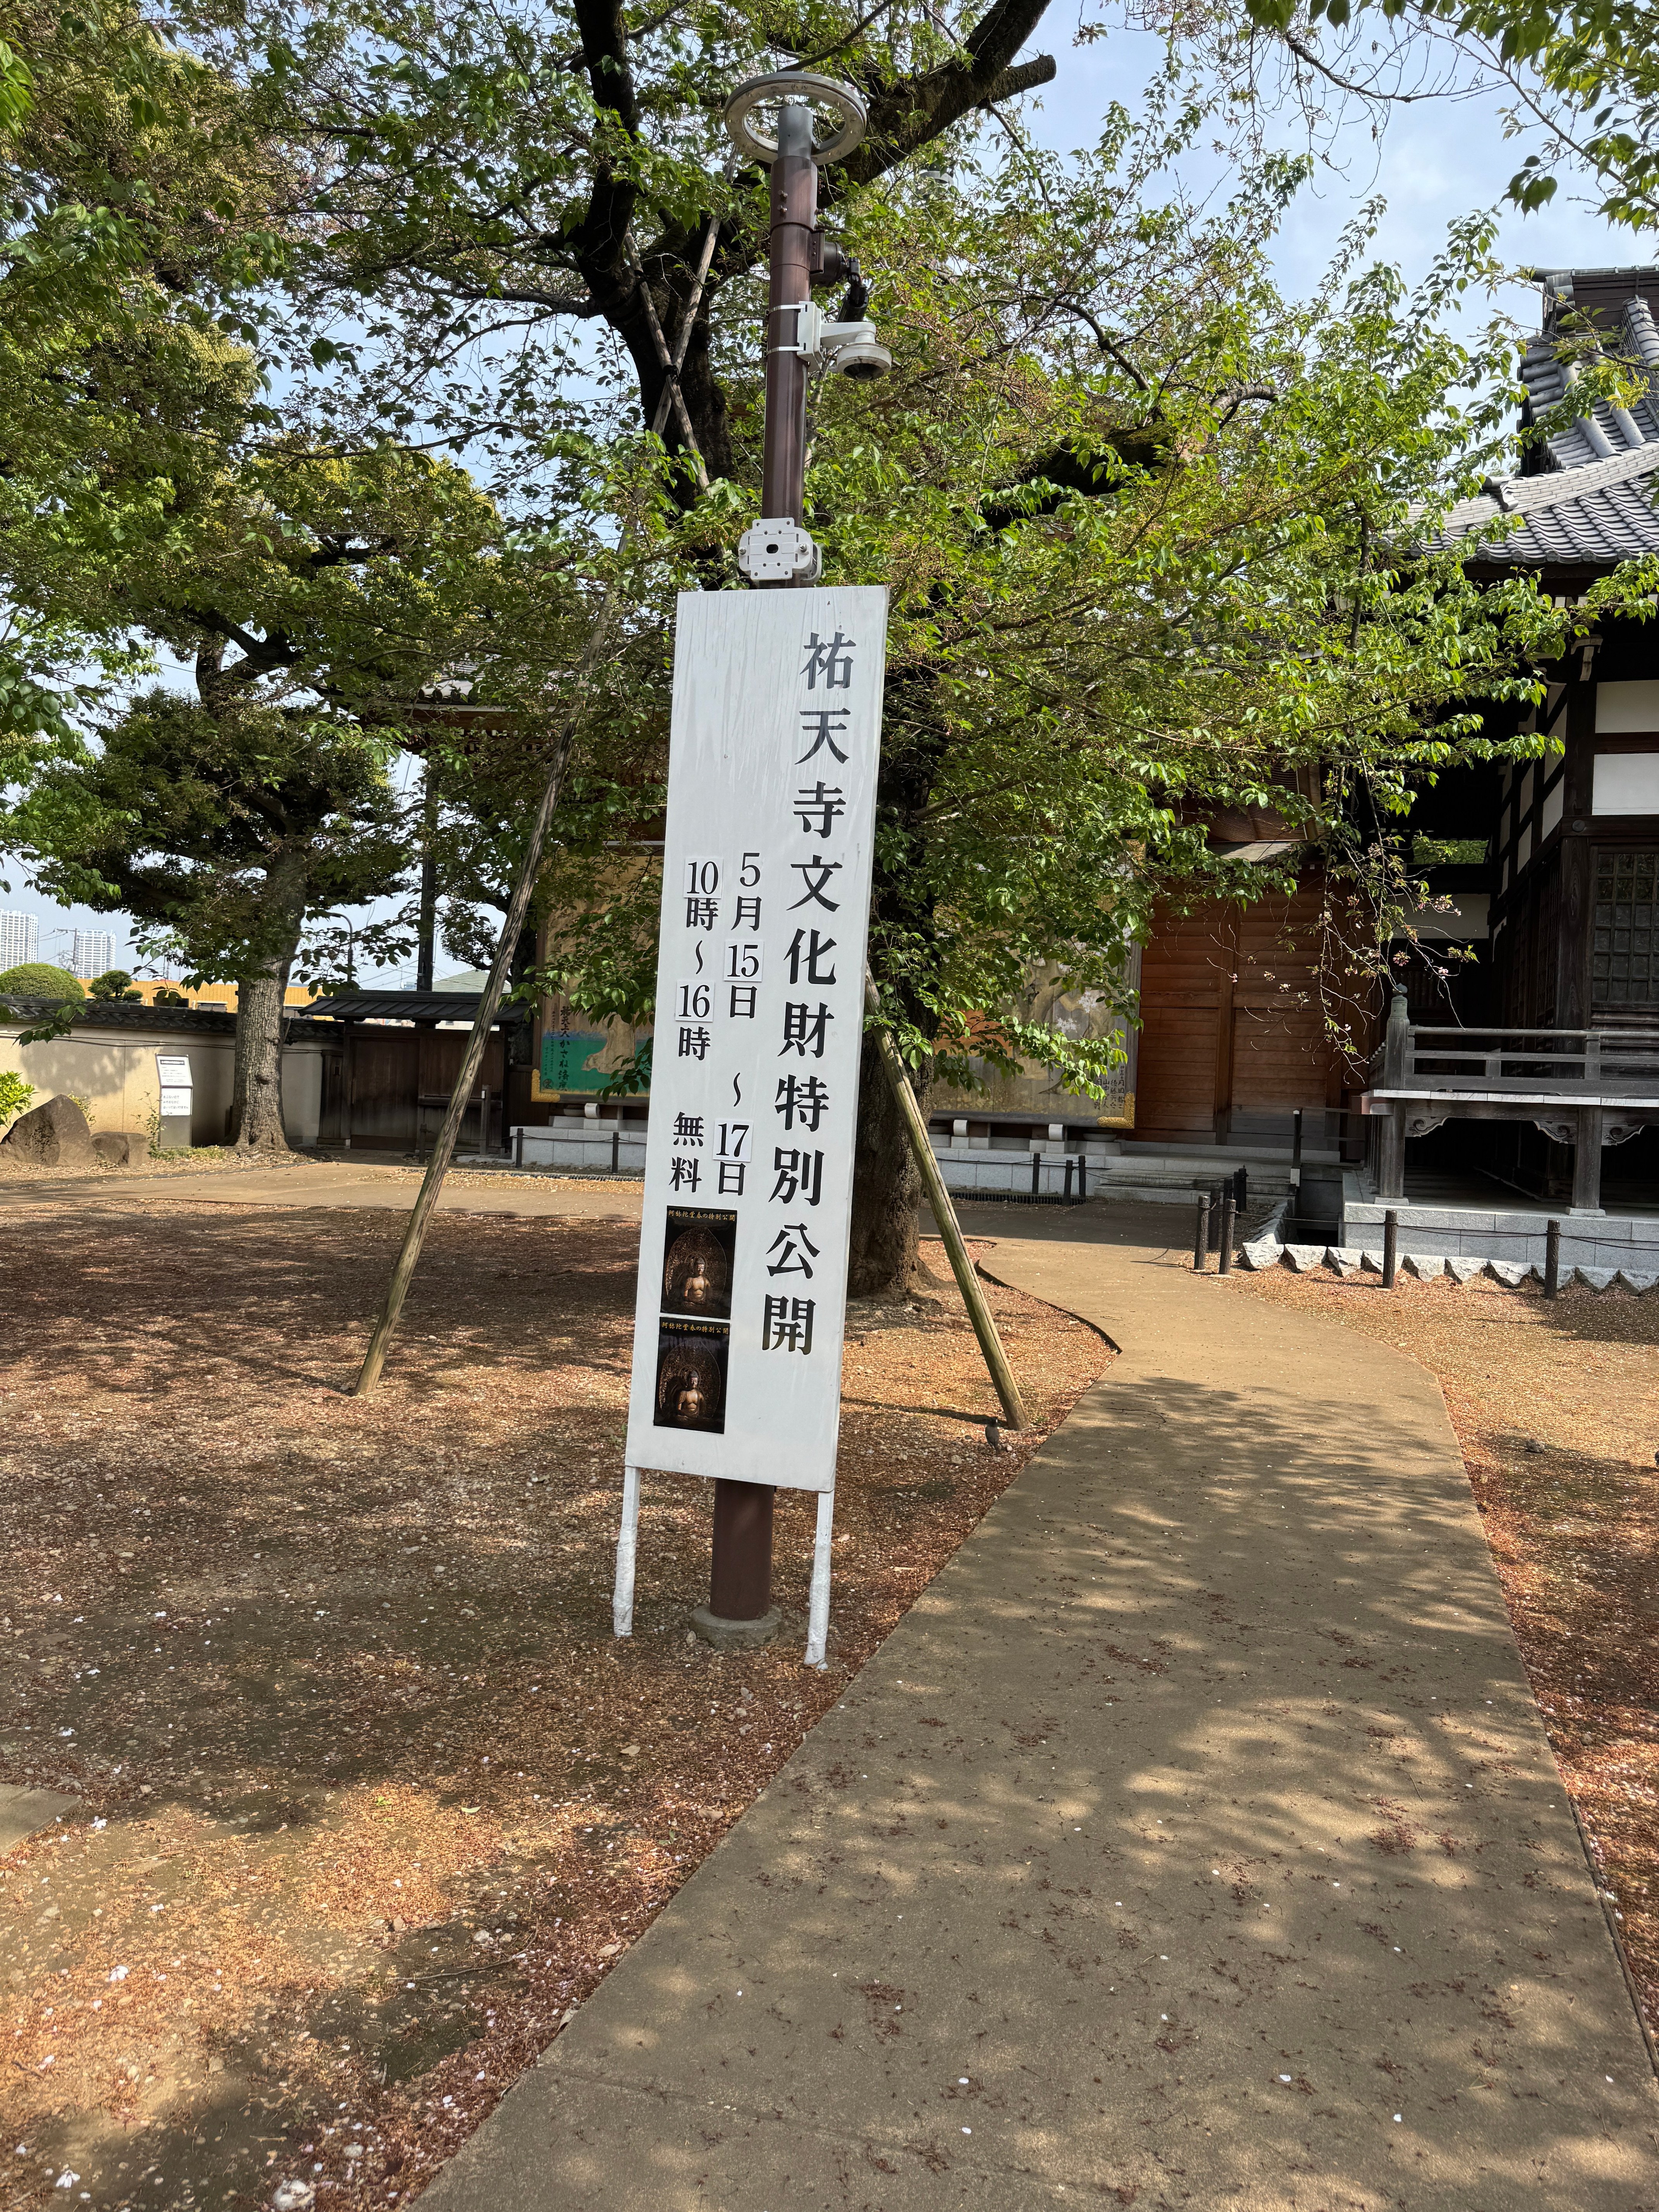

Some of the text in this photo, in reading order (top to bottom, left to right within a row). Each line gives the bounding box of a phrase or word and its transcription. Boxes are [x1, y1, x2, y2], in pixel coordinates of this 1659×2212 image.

[669, 1112, 704, 1192] 無料
[763, 632, 856, 1355] 祐天寺文化財特別公開
